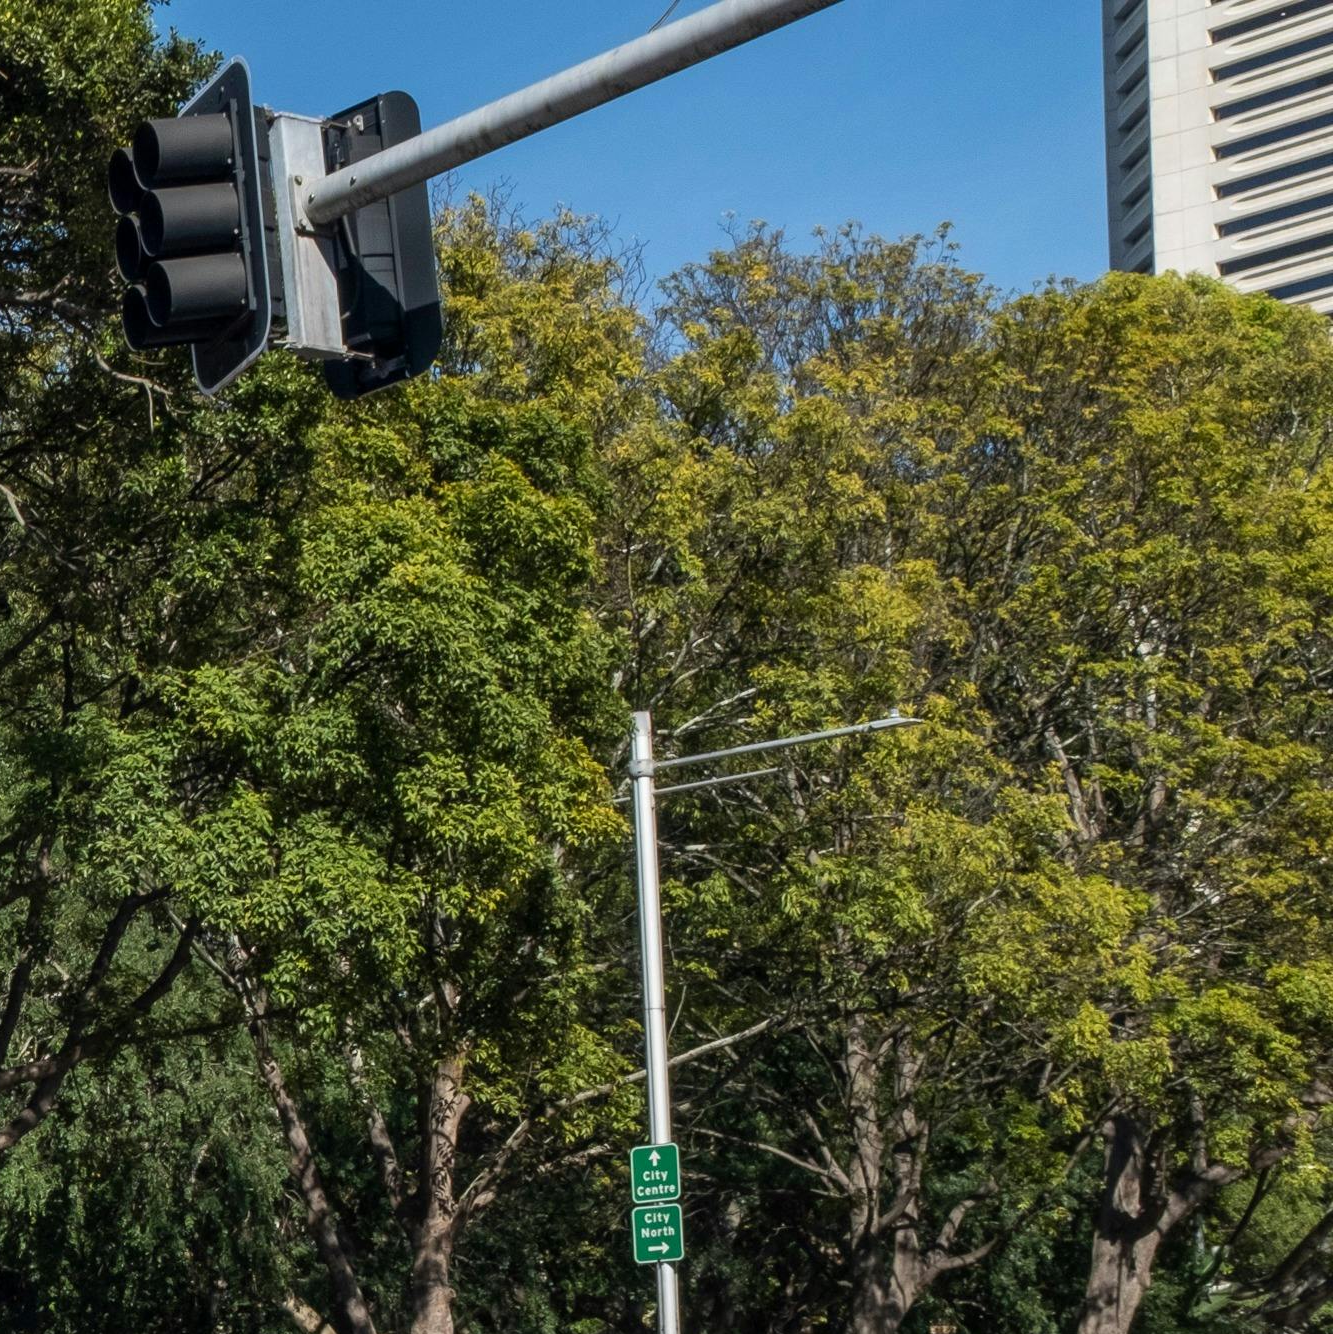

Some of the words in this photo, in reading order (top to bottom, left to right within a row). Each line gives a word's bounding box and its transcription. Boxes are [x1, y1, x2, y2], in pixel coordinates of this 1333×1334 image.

[643, 1169, 668, 1182] City
[637, 1183, 676, 1197] Centre
[644, 1212, 670, 1224] City
[641, 1226, 675, 1238] North
